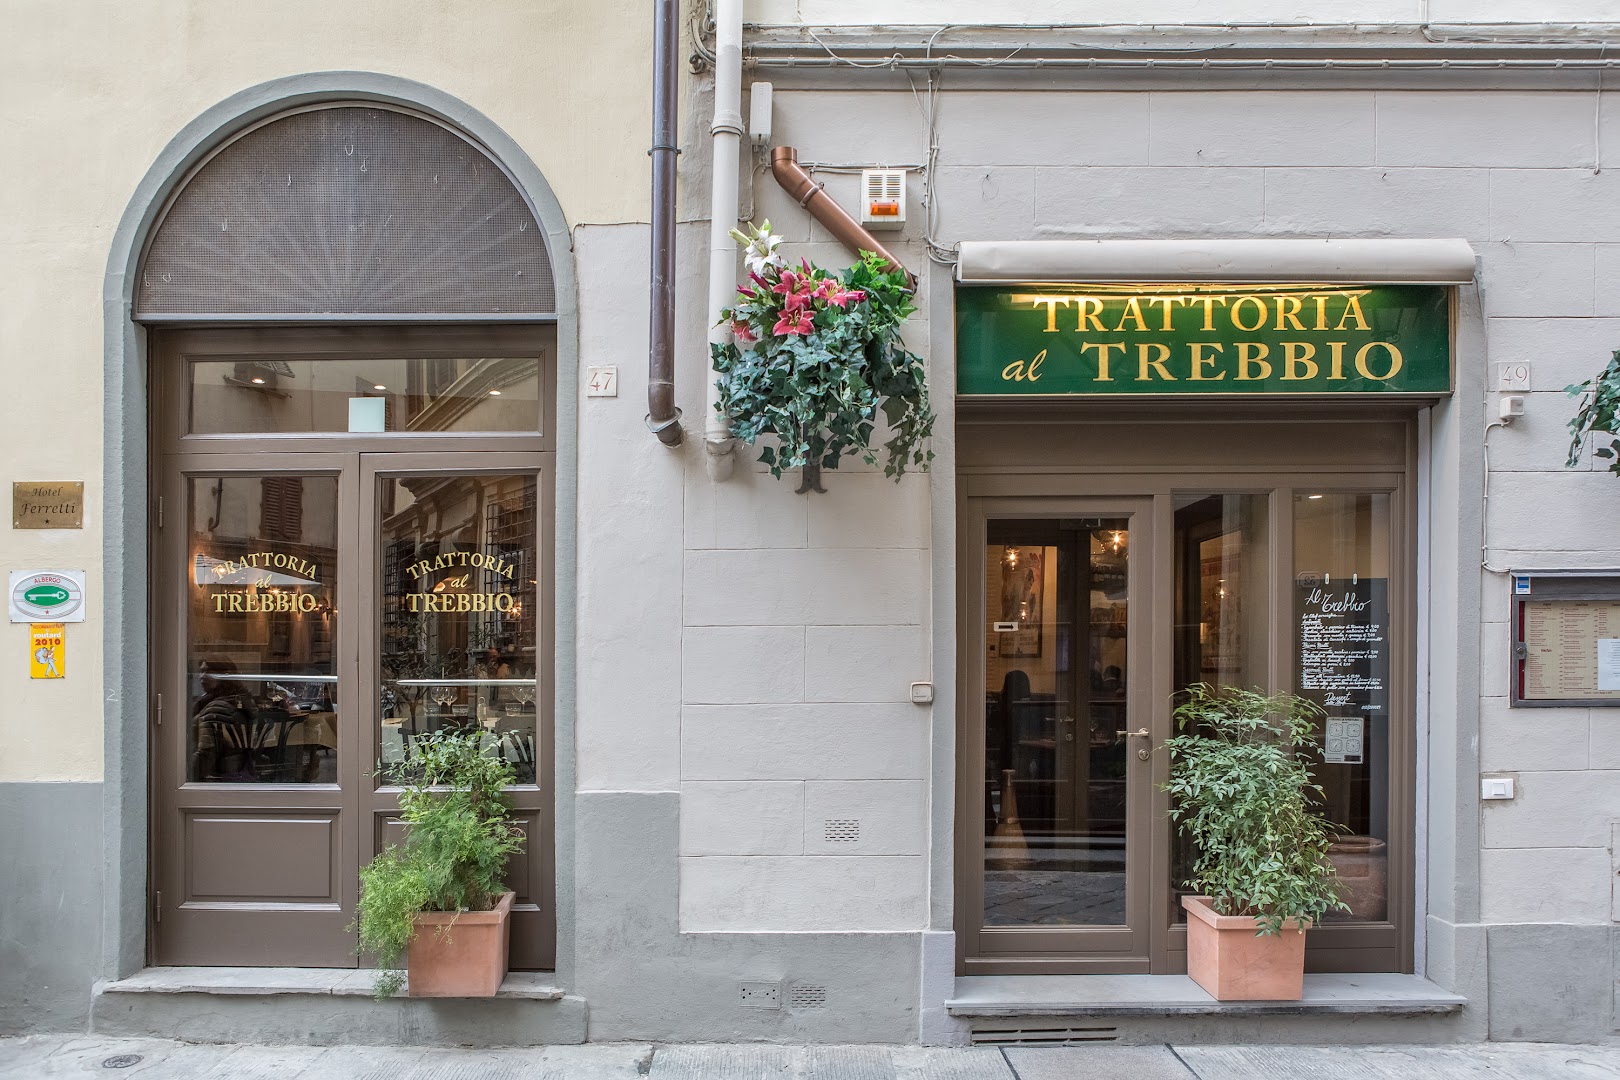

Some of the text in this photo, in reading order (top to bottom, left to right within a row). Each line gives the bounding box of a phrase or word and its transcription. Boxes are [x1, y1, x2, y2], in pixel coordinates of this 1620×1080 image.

[1032, 295, 1372, 333] TRATTORIA
[1001, 341, 1403, 382] al TREBBIO
[590, 372, 614, 391] 47
[1502, 365, 1528, 385] 49
[31, 486, 62, 497] Hotel
[19, 502, 76, 517] Ferretti
[211, 552, 317, 580] TRATTORIA
[406, 551, 514, 580] TRATTORIA
[34, 576, 62, 584] ALBERGO
[255, 574, 272, 588] al
[450, 573, 469, 588] al
[211, 593, 316, 613] TREBBIO
[406, 593, 514, 613] TREBBIO
[1320, 592, 1372, 613] Trebbio
[35, 638, 61, 646] 2010
